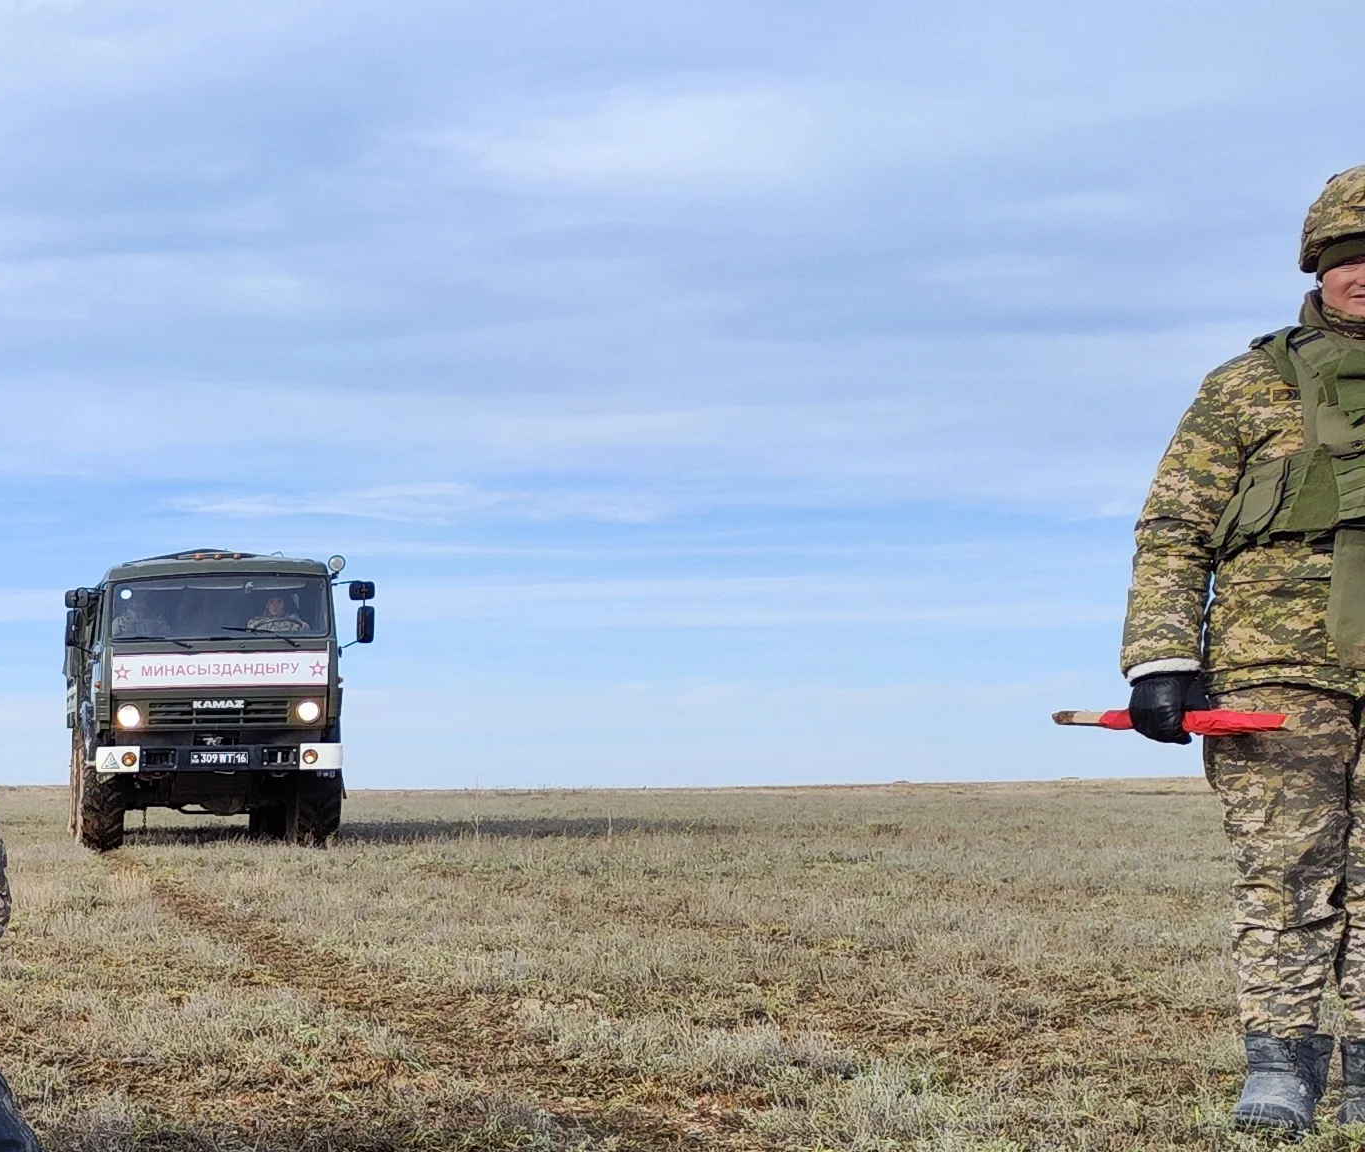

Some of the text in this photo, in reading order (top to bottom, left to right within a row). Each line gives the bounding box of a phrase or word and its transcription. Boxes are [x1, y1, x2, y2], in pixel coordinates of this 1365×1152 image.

[141, 662, 300, 677] МИНАСЫЗДАНДЫРУ
[192, 699, 245, 709] KAMAZ
[200, 753, 219, 764] 309
[235, 753, 247, 764] 16
